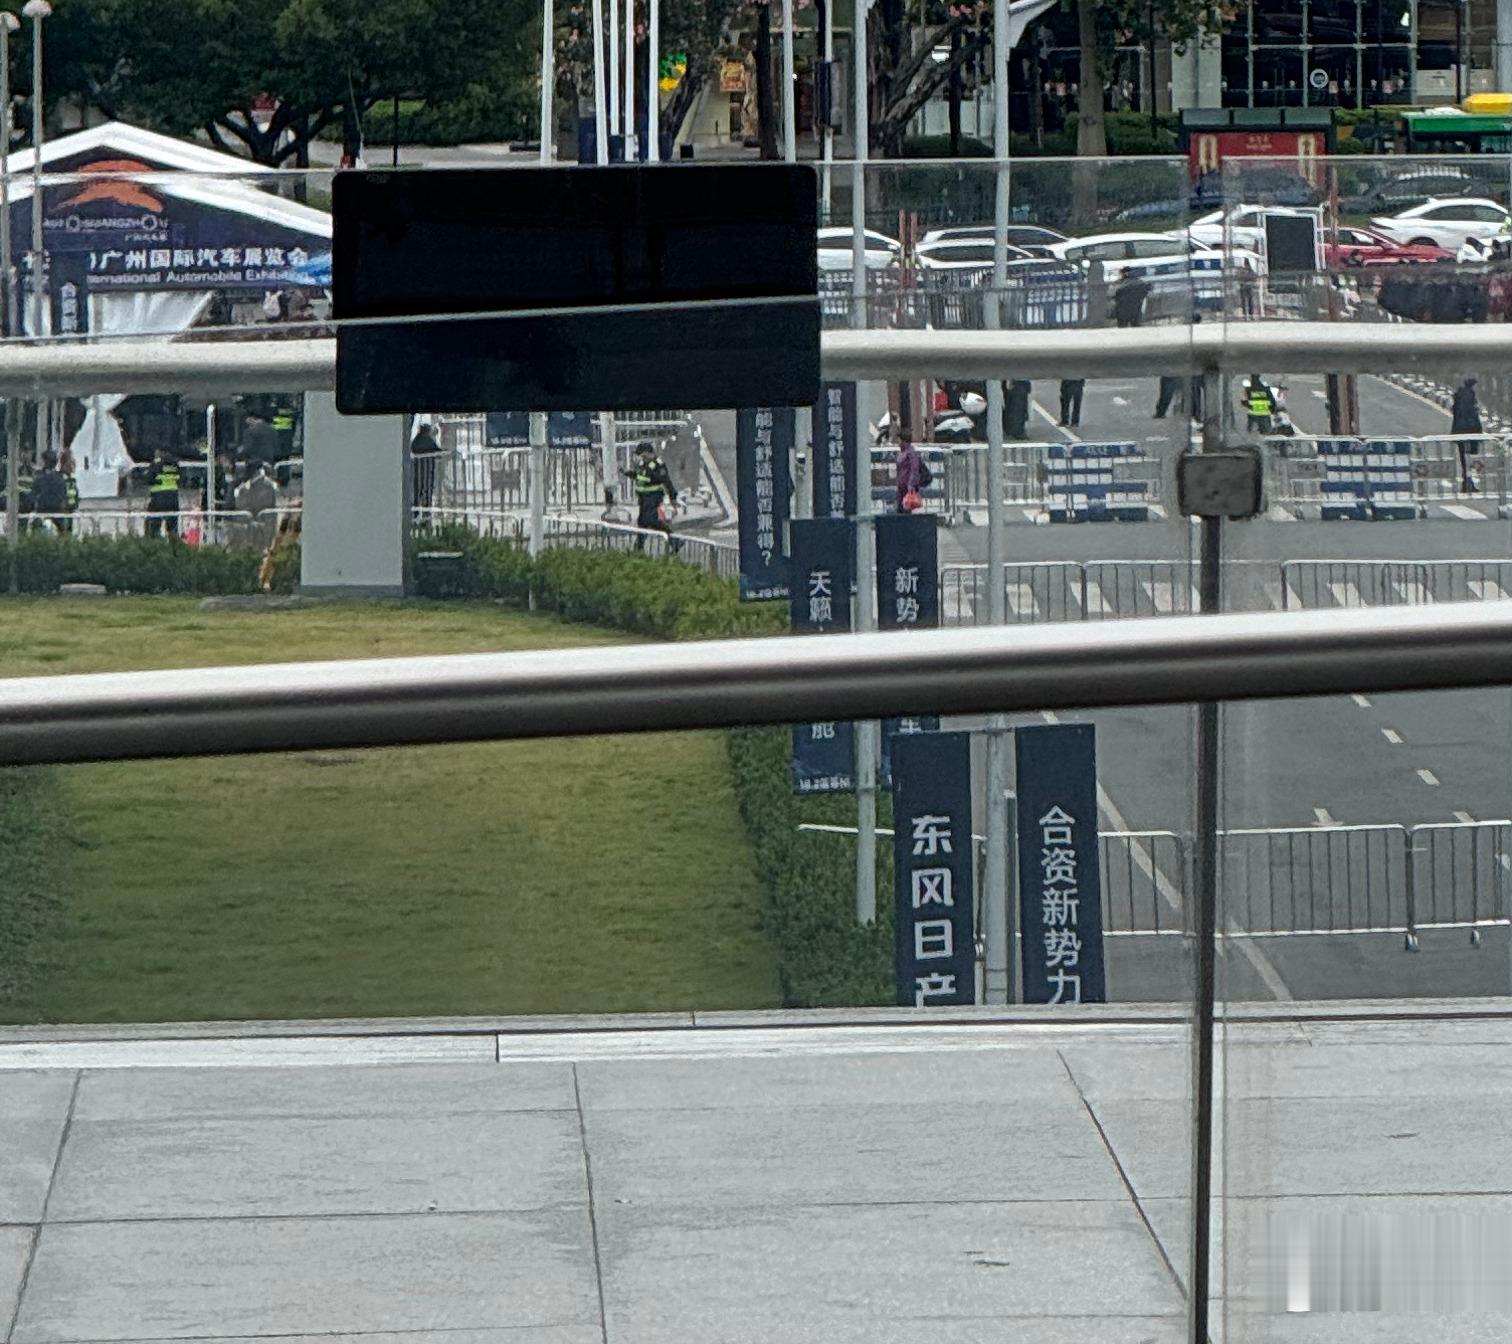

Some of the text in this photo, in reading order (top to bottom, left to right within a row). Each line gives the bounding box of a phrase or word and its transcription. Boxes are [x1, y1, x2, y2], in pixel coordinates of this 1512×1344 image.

[89, 246, 309, 271] 广州国际汽车展览会
[911, 814, 957, 1008] 东风日产
[1038, 805, 1082, 1005] 合资新势力
